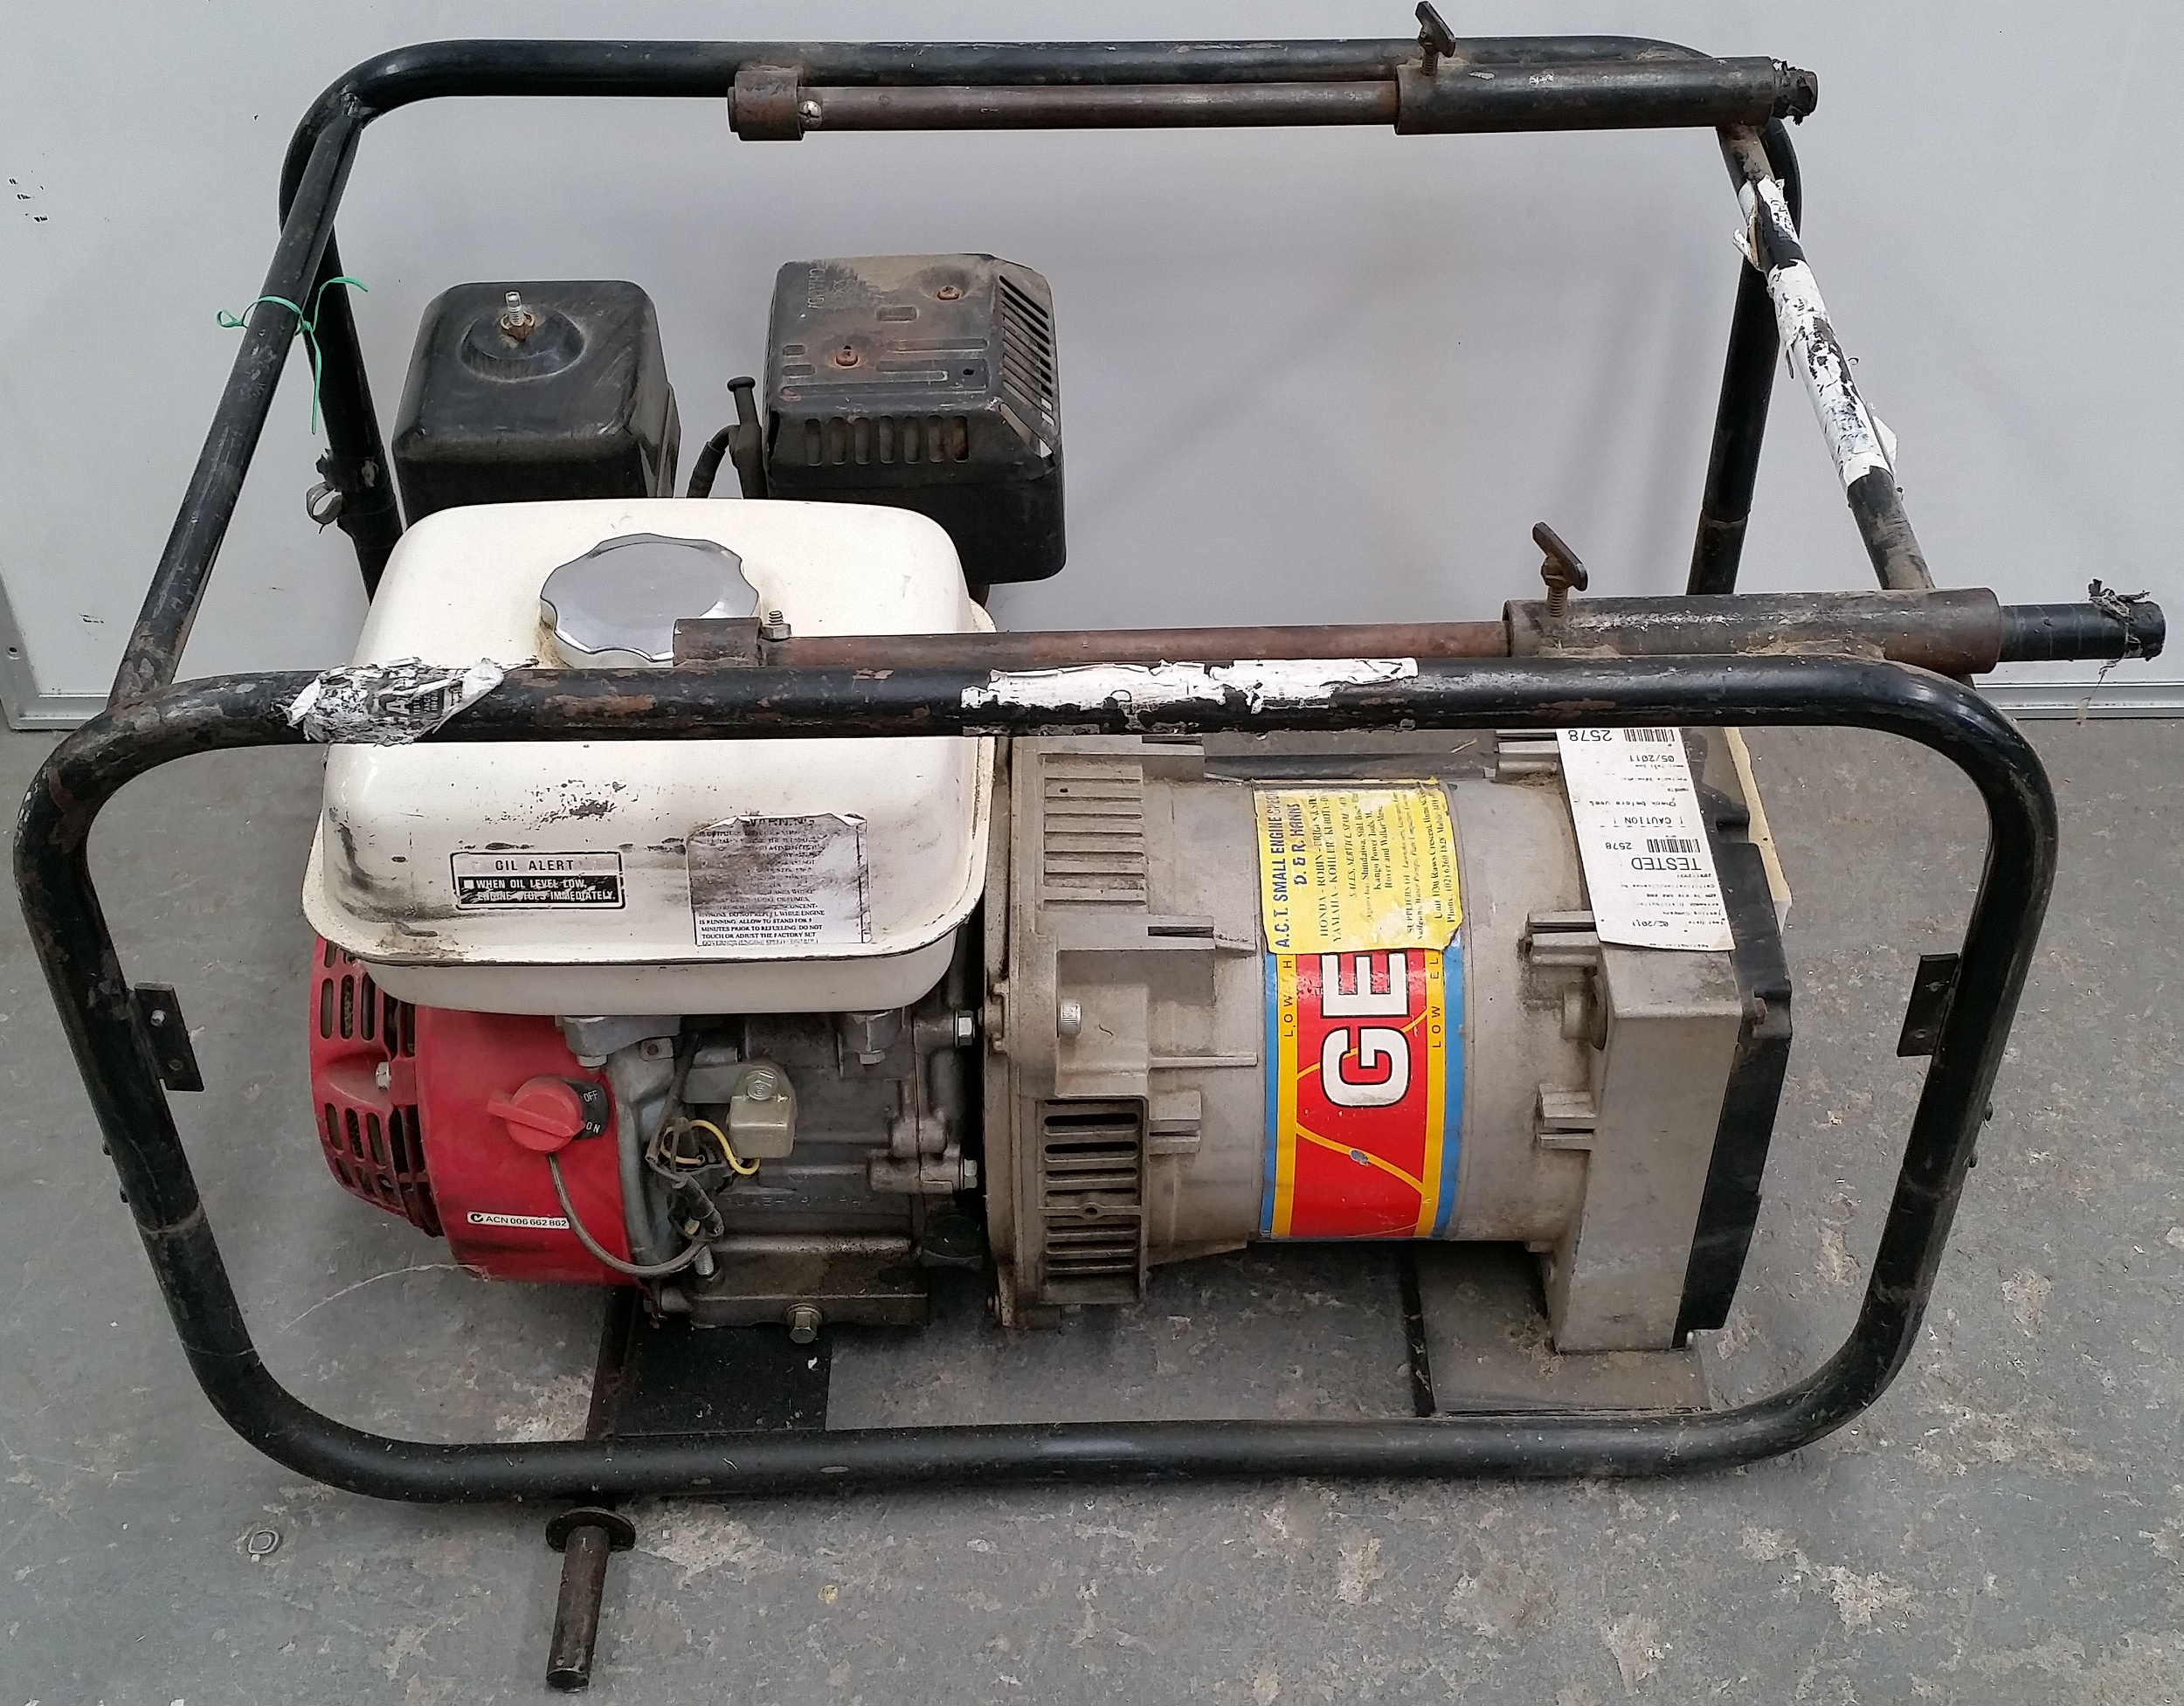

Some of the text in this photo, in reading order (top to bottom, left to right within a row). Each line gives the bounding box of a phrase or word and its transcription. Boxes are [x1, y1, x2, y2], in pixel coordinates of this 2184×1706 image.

[1567, 729, 1613, 742] 2578
[1268, 817, 1284, 853] ENGINE
[1371, 839, 1379, 860] Power
[1381, 848, 1390, 861] and
[495, 860, 574, 871] OIL ALERT
[1292, 857, 1305, 866] &
[1315, 854, 1325, 886] ROBIN
[1325, 842, 1337, 882] KOHLER
[1631, 857, 1701, 871] TESTED
[476, 879, 587, 889] WHEN OIL LEVEL LOW,
[1272, 859, 1288, 901] SMALL
[550, 890, 616, 901] IMMEDIATELY.
[1319, 896, 1328, 936] HONDA
[1330, 893, 1341, 942] YAMAHA
[1282, 994, 1294, 1038] LOW
[1320, 952, 1411, 1108] GE
[1430, 1005, 1441, 1048] LOW
[583, 1090, 598, 1102] OFF
[585, 1122, 601, 1134] ON
[486, 1215, 508, 1224] ACN
[510, 1217, 529, 1226] 006
